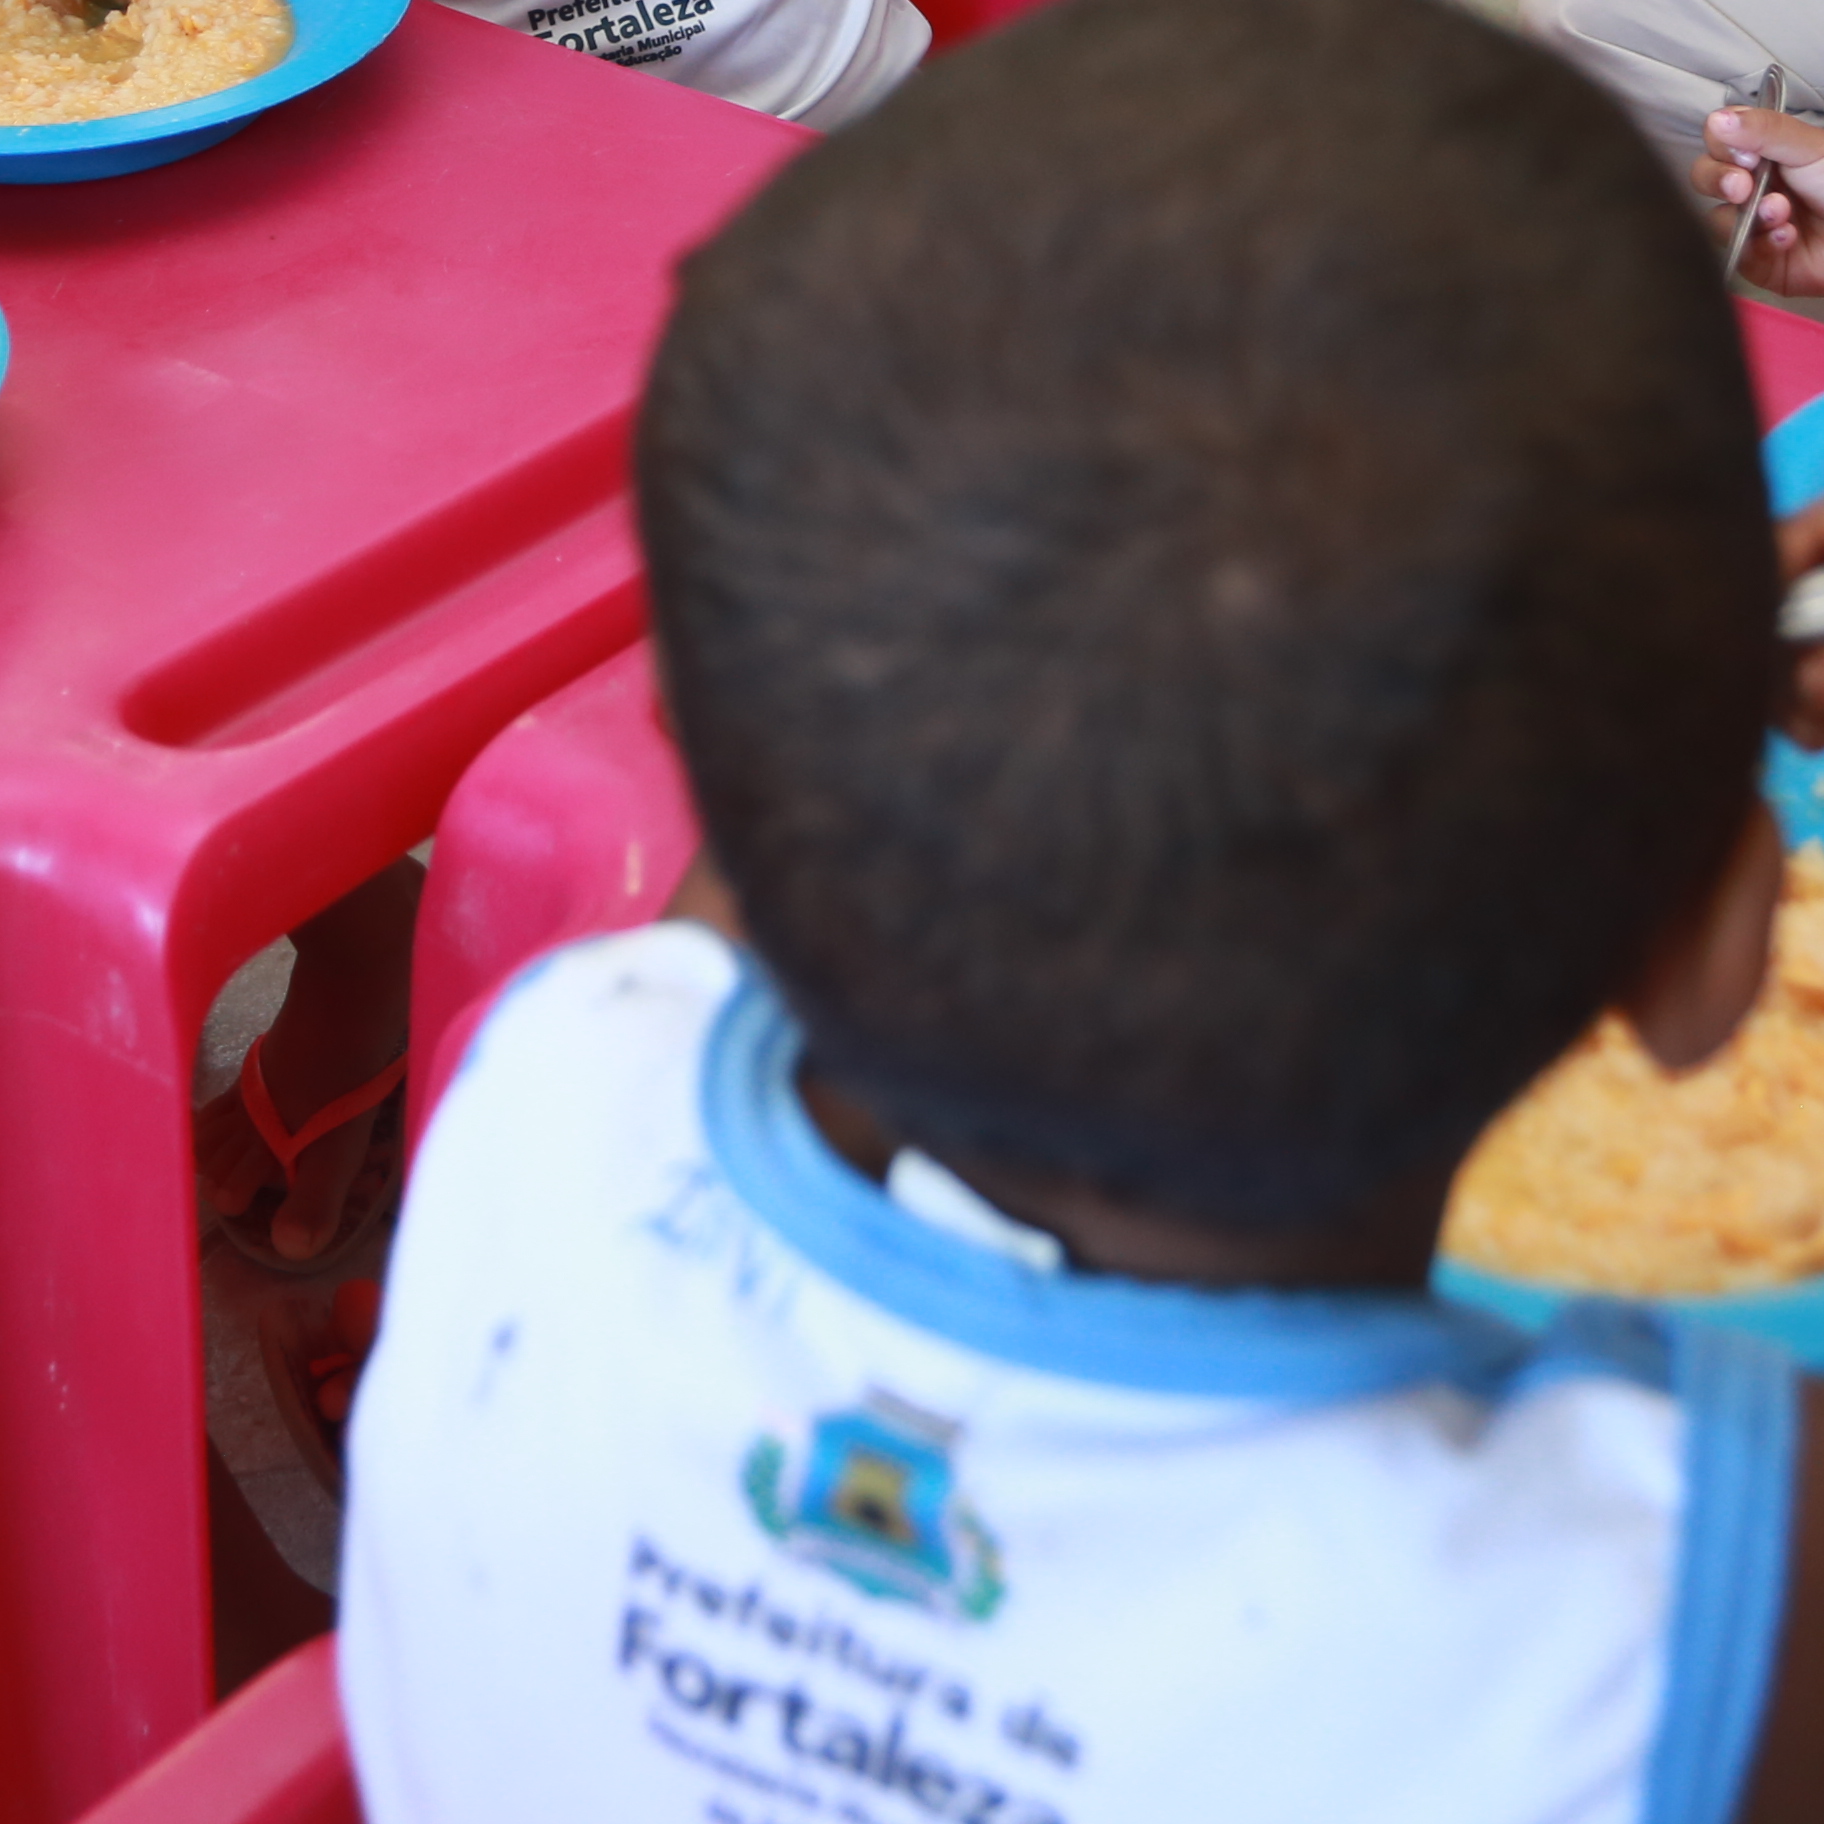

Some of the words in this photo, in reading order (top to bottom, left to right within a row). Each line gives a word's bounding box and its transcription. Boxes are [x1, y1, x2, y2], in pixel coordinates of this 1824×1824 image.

[637, 20, 706, 52] Municipal
[629, 1532, 973, 1722] Prefeitura
[1000, 1694, 1081, 1770] de
